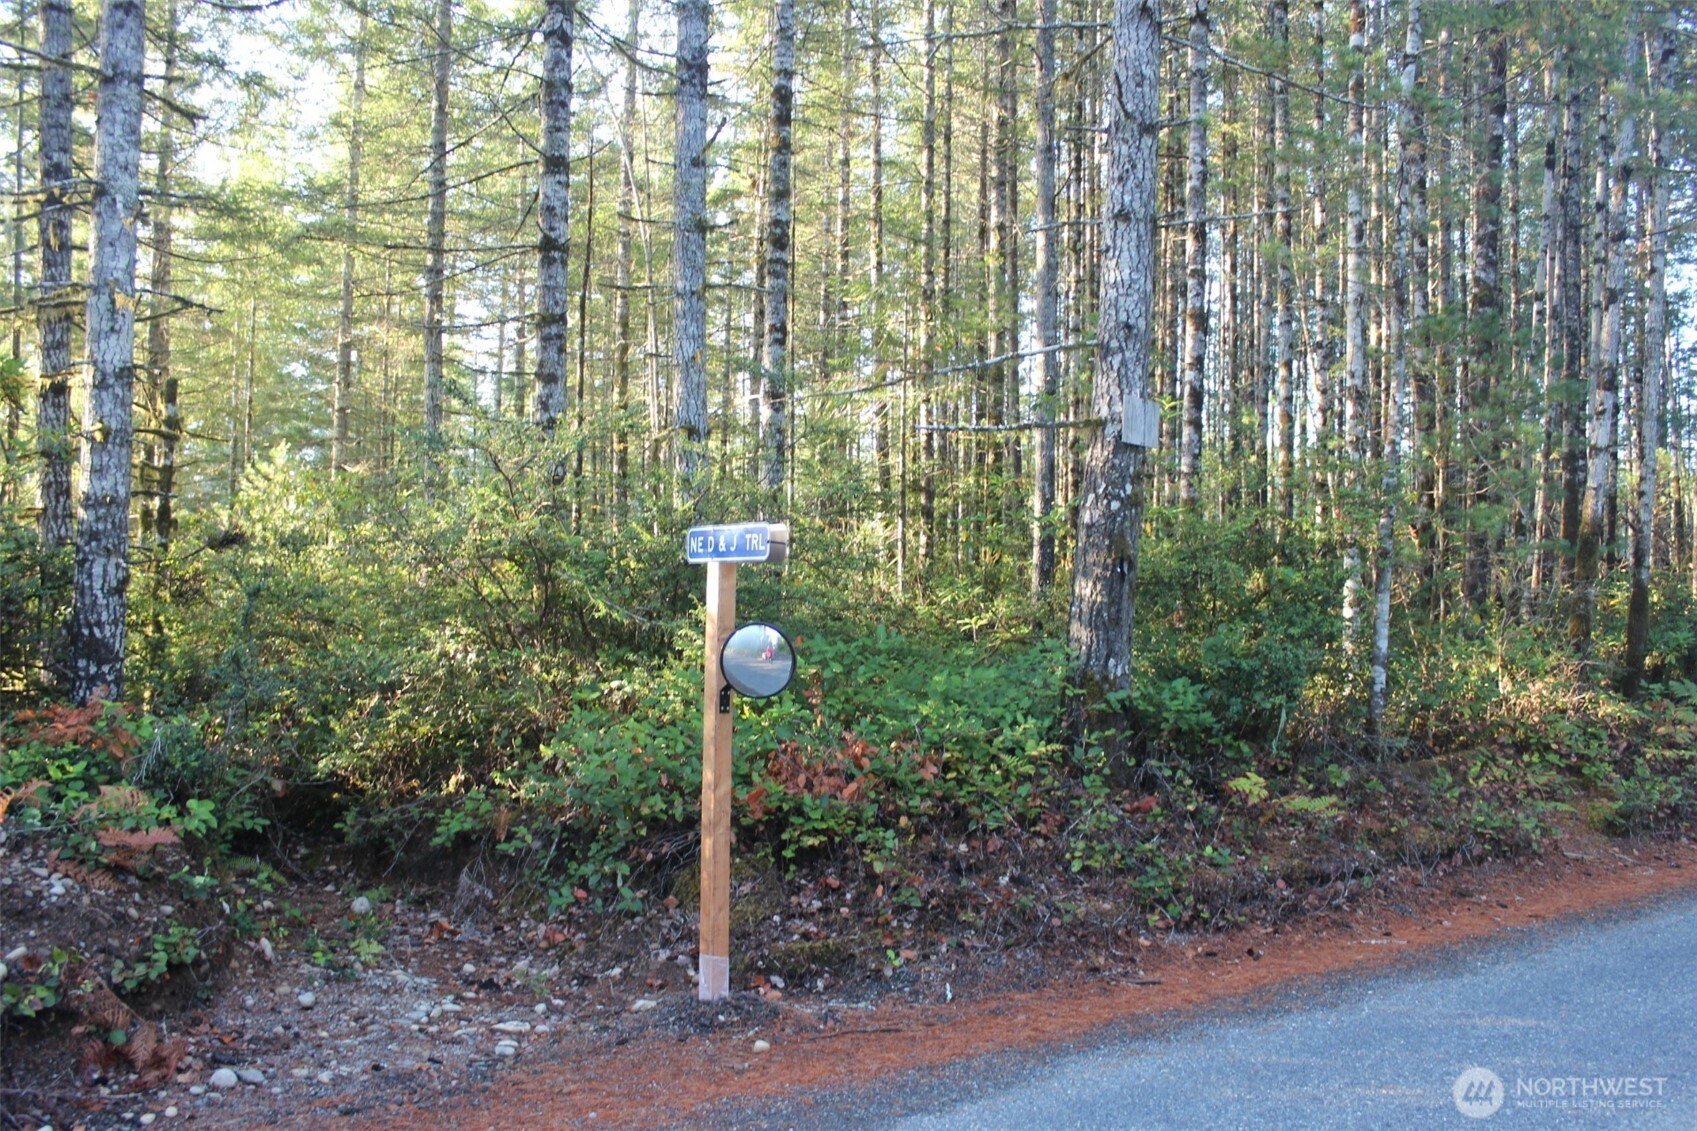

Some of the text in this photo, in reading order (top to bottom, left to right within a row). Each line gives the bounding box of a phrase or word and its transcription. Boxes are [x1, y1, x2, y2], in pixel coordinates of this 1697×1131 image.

[690, 533, 765, 553] NE D & J TRL
